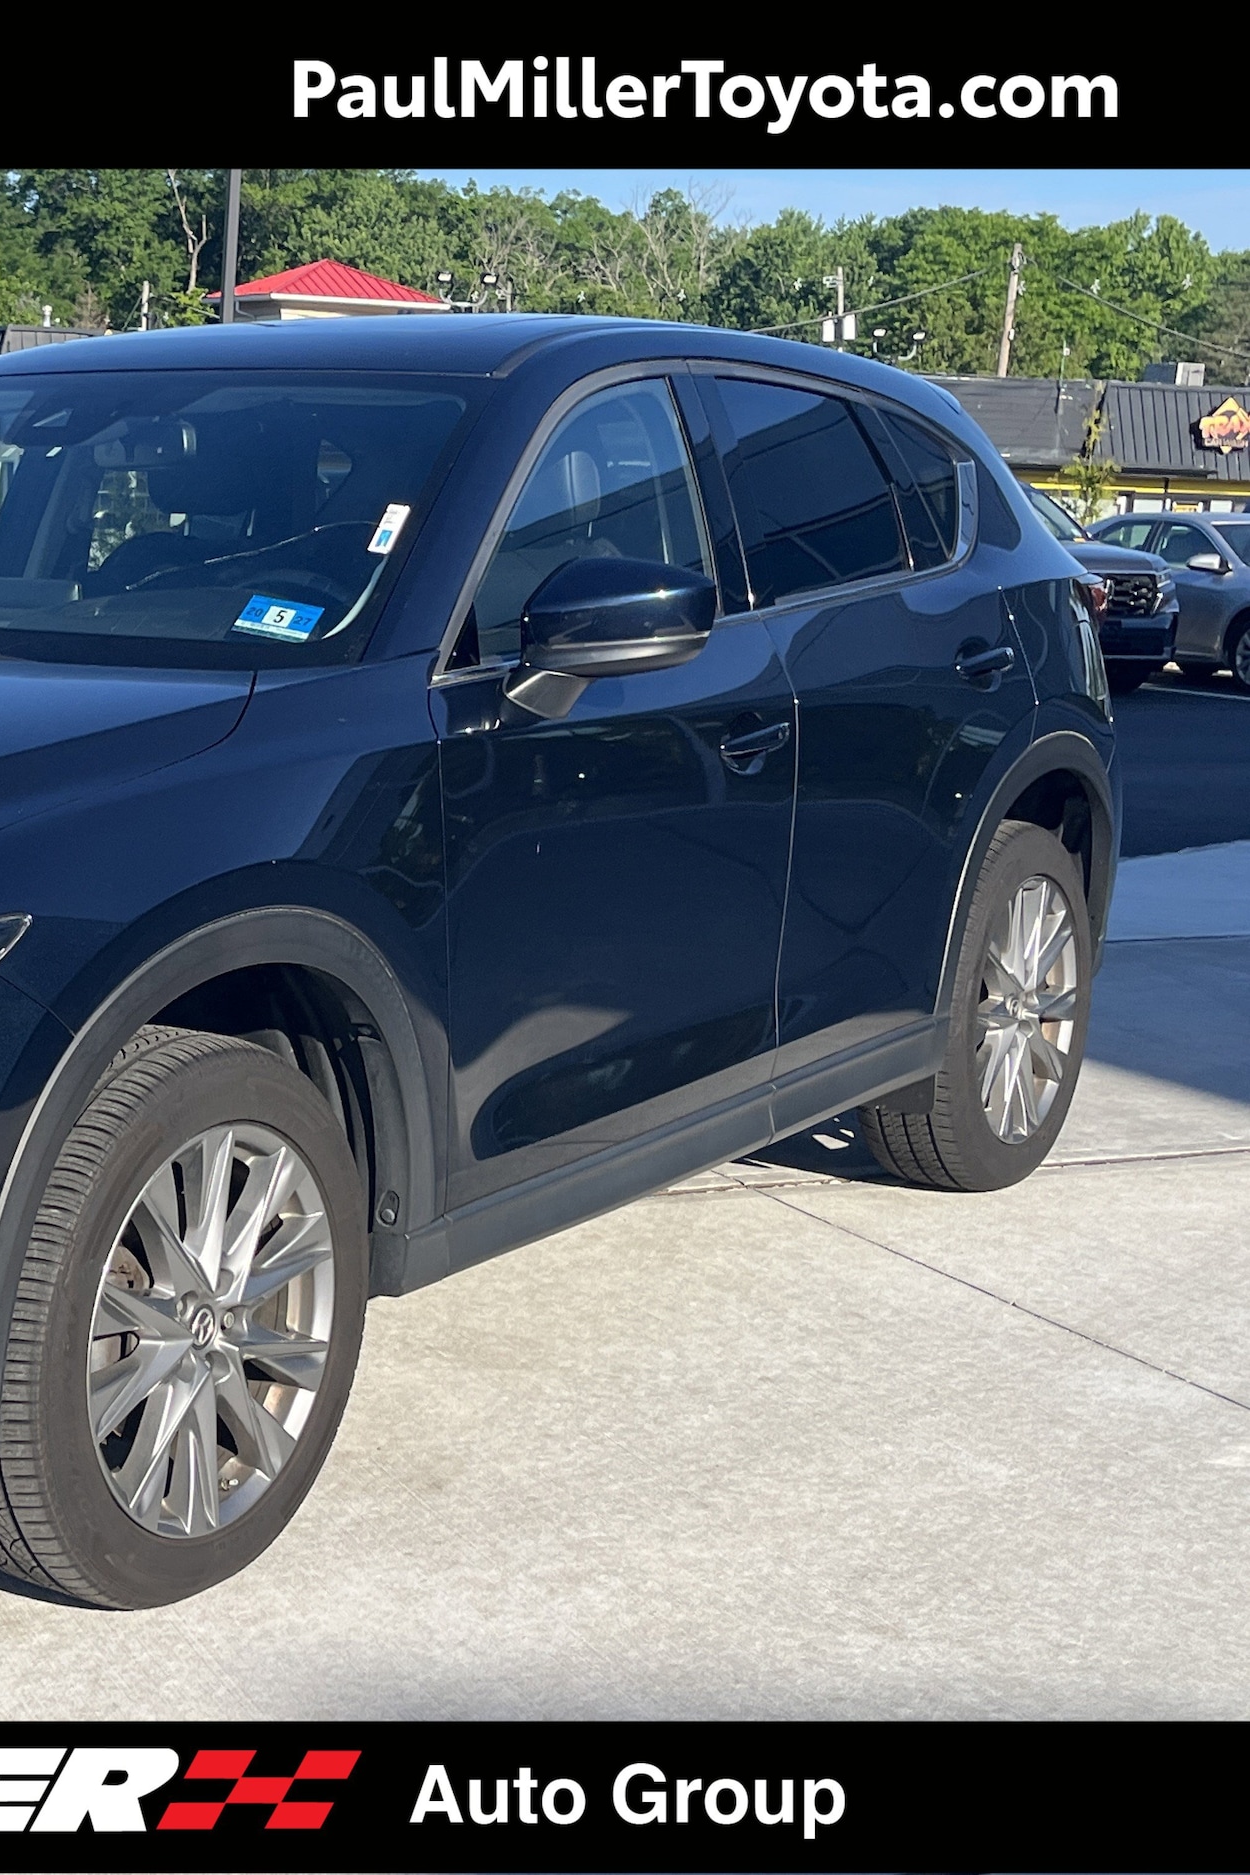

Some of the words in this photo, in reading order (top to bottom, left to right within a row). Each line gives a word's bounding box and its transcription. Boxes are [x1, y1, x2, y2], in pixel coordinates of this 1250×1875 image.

[246, 606, 264, 618] 20
[273, 609, 288, 624] 5
[292, 615, 312, 627] 27
